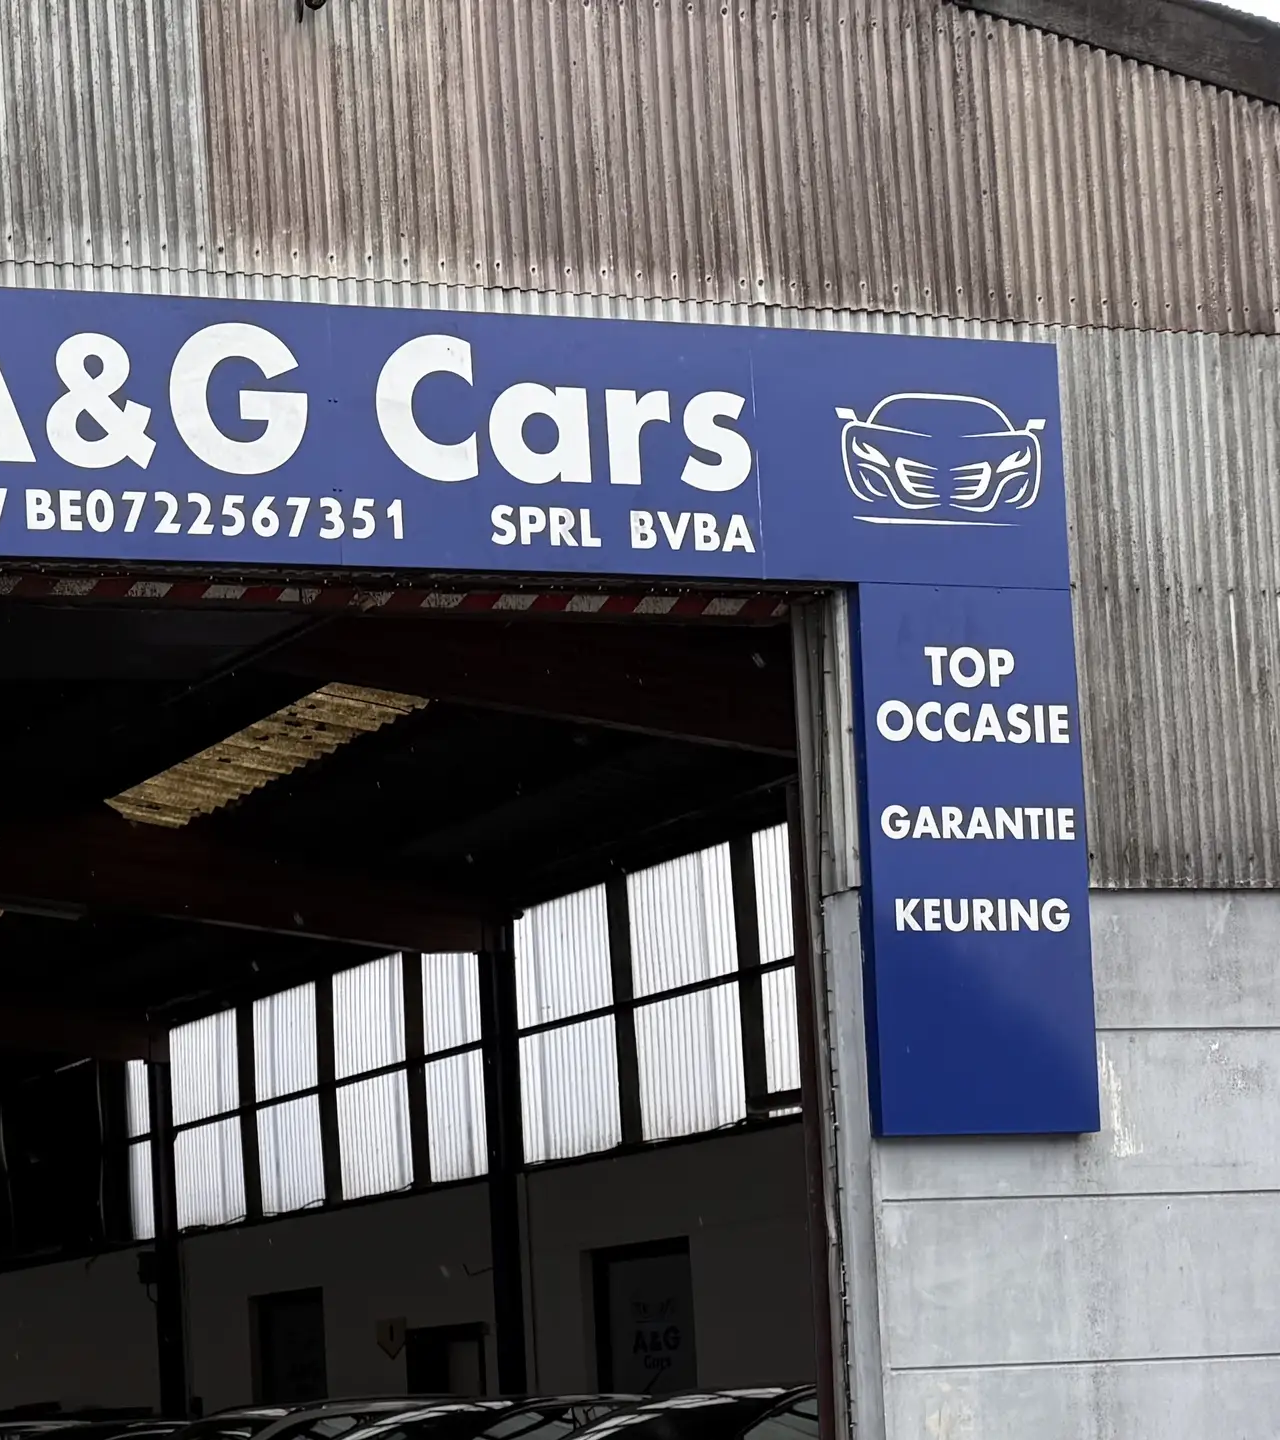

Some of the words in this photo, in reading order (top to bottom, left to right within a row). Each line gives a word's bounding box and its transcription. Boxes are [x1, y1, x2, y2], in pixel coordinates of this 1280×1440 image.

[375, 334, 752, 492] Cars
[25, 488, 404, 540] BE0722567351
[490, 504, 601, 548] SPRL
[630, 510, 756, 554] BVBA
[924, 646, 1015, 688] TOP
[876, 700, 1070, 744] OCCASIE
[880, 804, 1075, 840] GARANTIE
[895, 898, 1071, 932] KEURING
